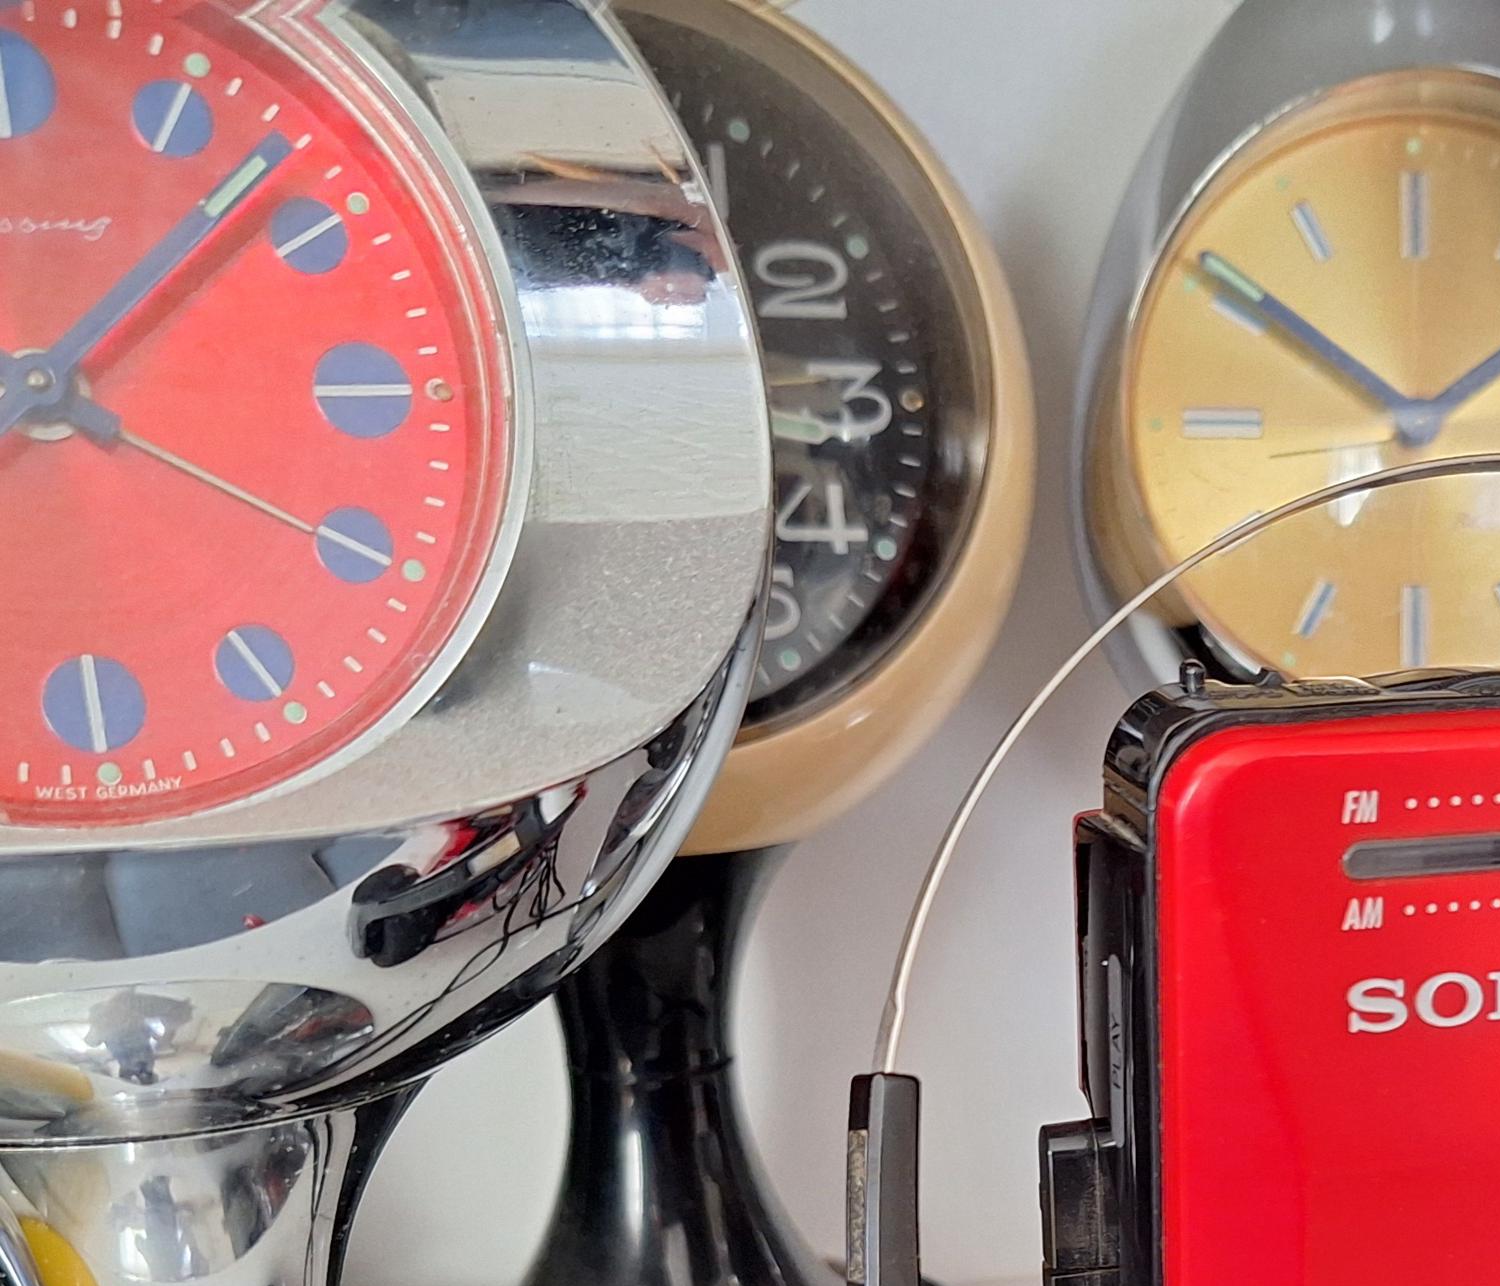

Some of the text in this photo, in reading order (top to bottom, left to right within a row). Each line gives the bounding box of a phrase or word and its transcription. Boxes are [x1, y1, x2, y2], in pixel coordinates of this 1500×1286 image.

[807, 359, 893, 437] 3
[777, 484, 870, 555] 4
[35, 776, 182, 800] WEST GERMANY
[1342, 790, 1379, 824] FM
[1342, 897, 1384, 931] AM
